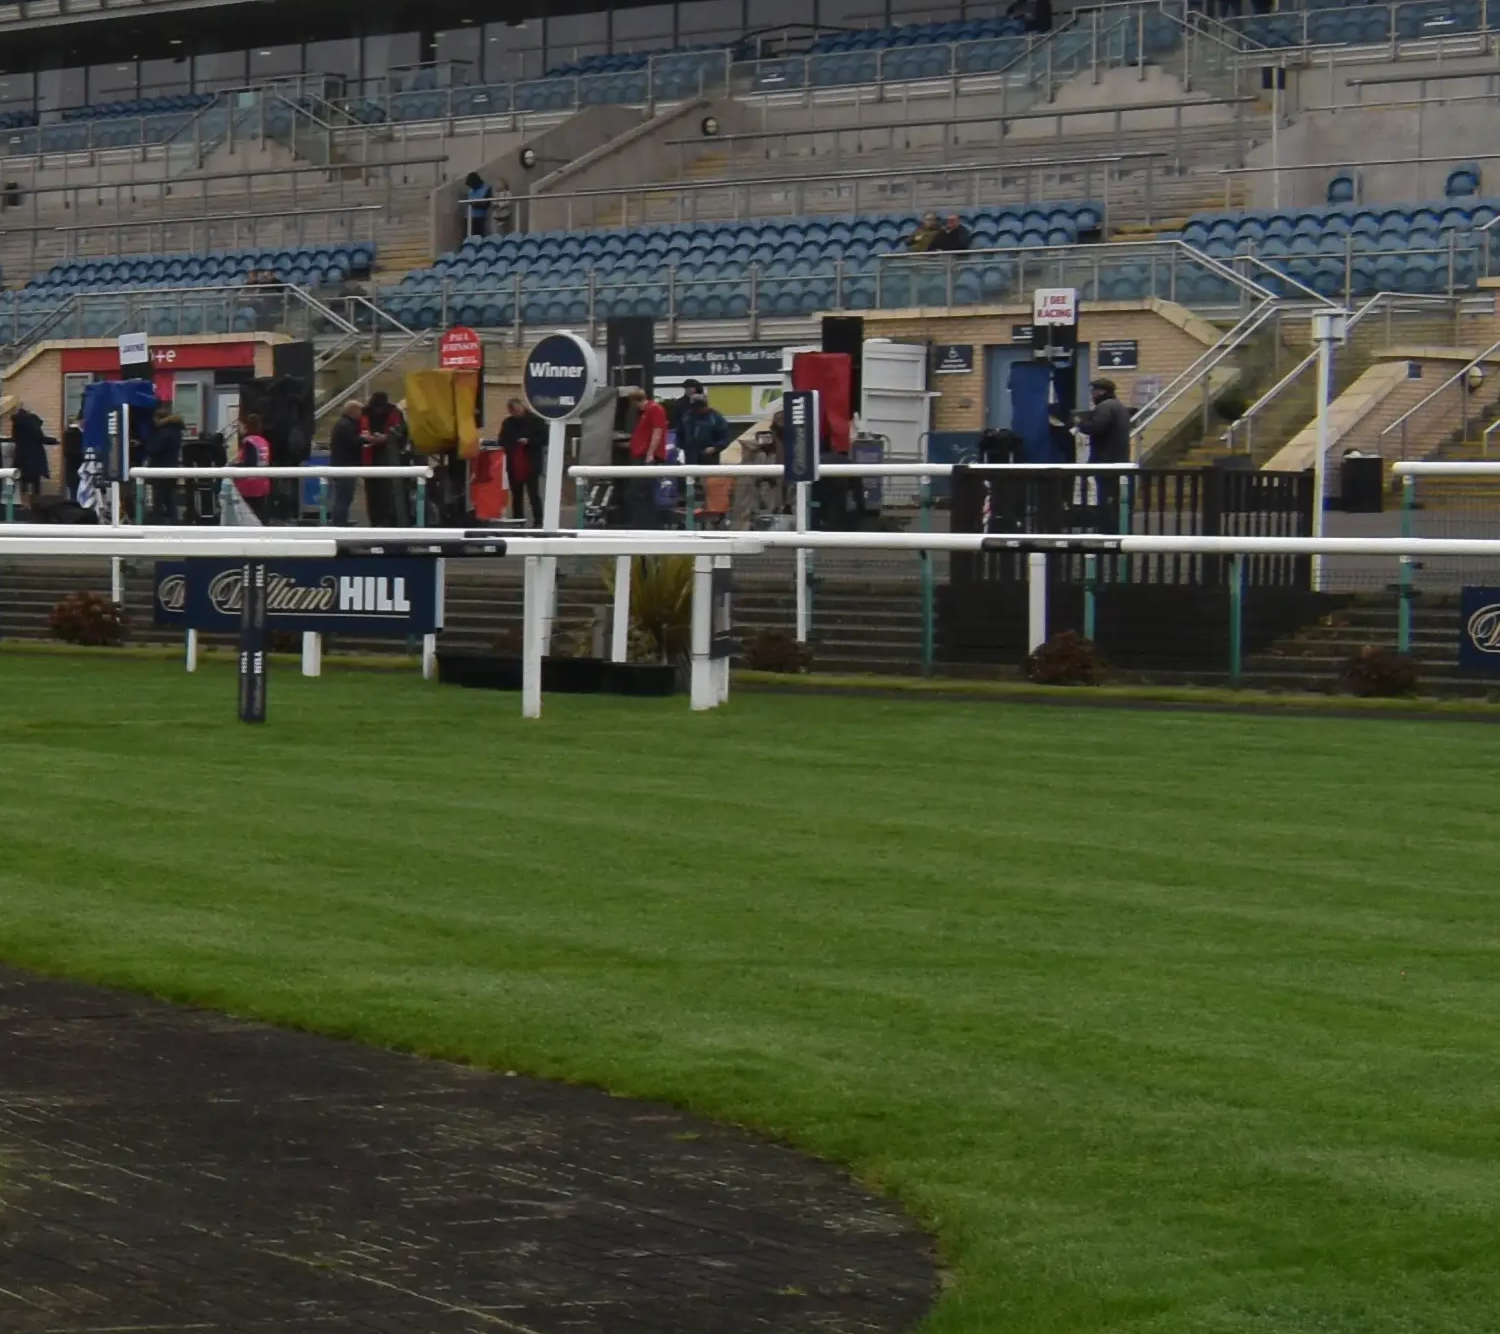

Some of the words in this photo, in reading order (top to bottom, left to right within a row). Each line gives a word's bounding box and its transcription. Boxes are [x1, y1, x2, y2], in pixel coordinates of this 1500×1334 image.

[530, 361, 584, 378] Winner
[792, 397, 806, 425] HILL
[339, 576, 411, 612] HILL
